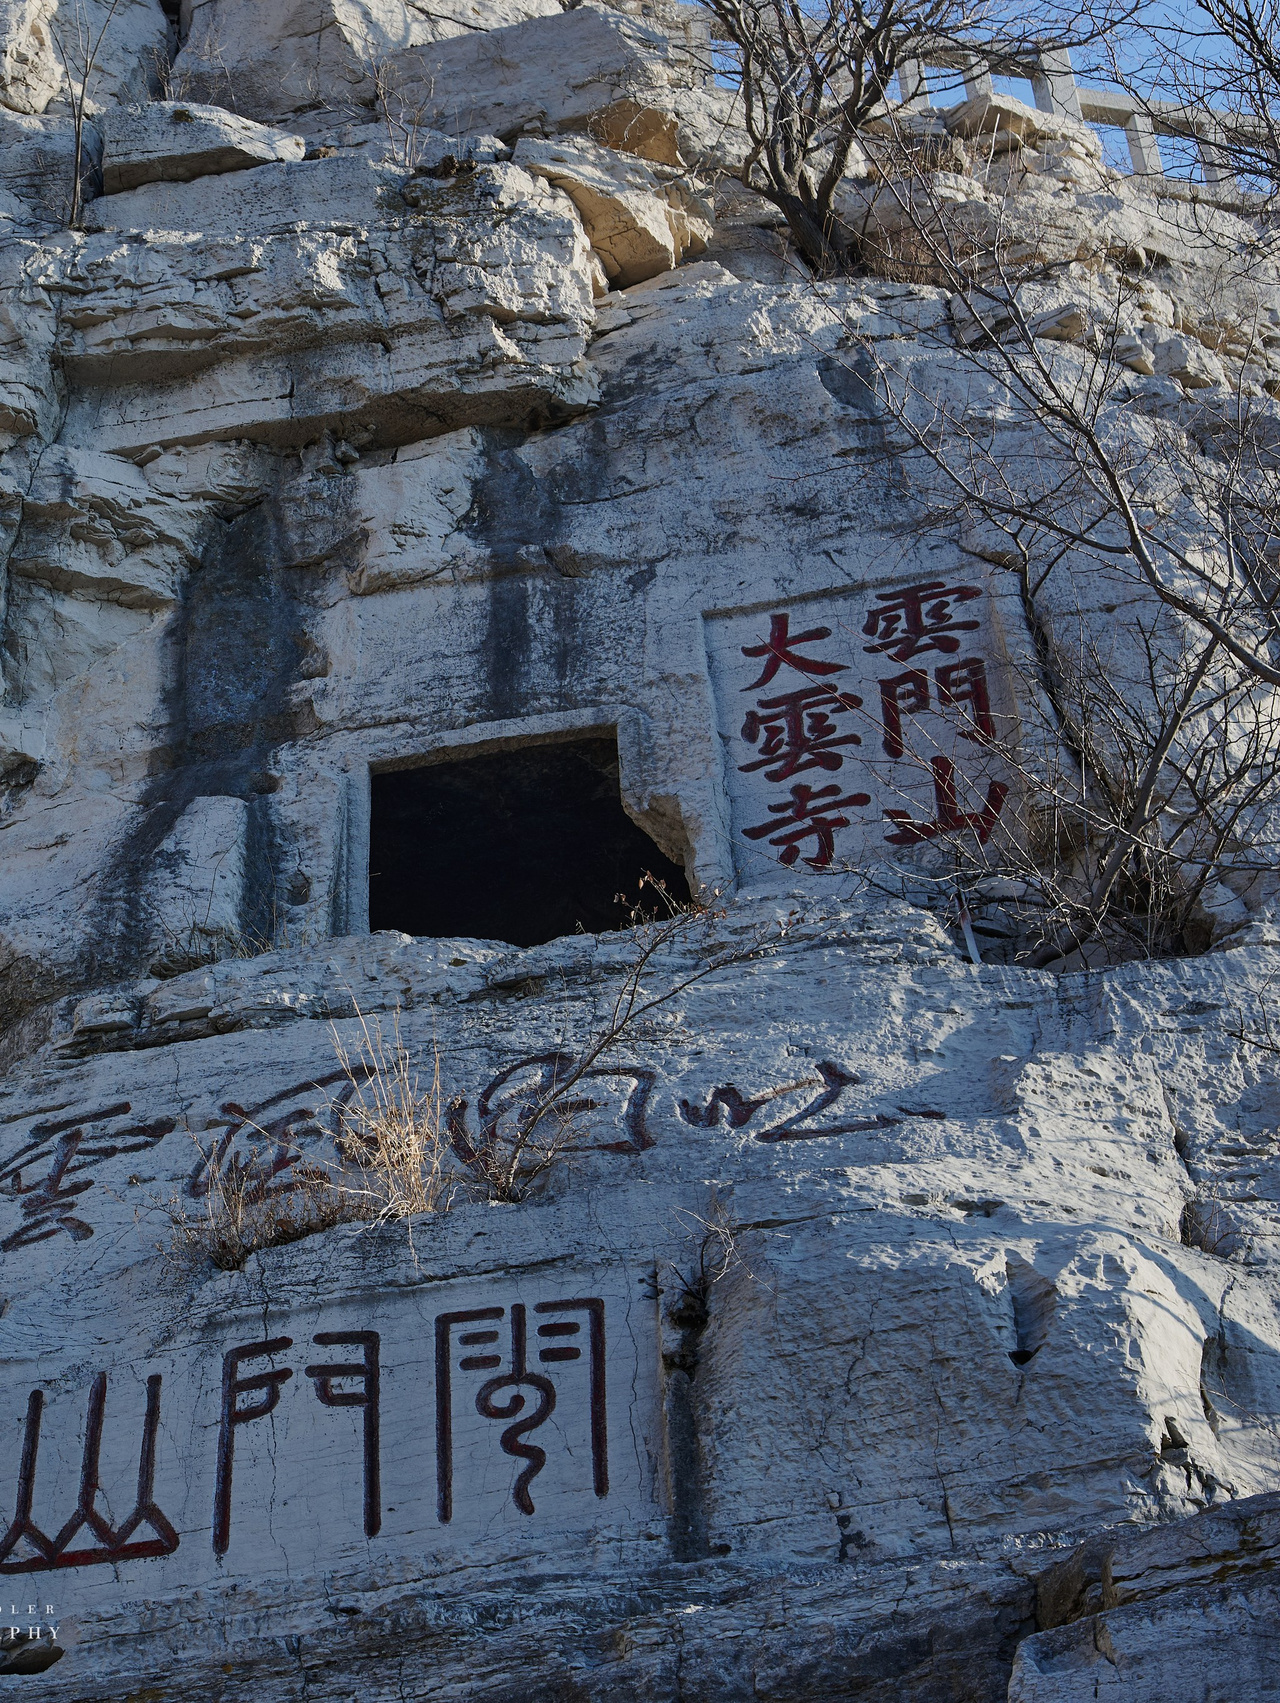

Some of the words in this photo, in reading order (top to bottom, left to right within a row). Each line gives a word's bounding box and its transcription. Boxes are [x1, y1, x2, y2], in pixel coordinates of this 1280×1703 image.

[738, 612, 871, 871] 大雲寺
[862, 581, 1010, 846] 雲門山
